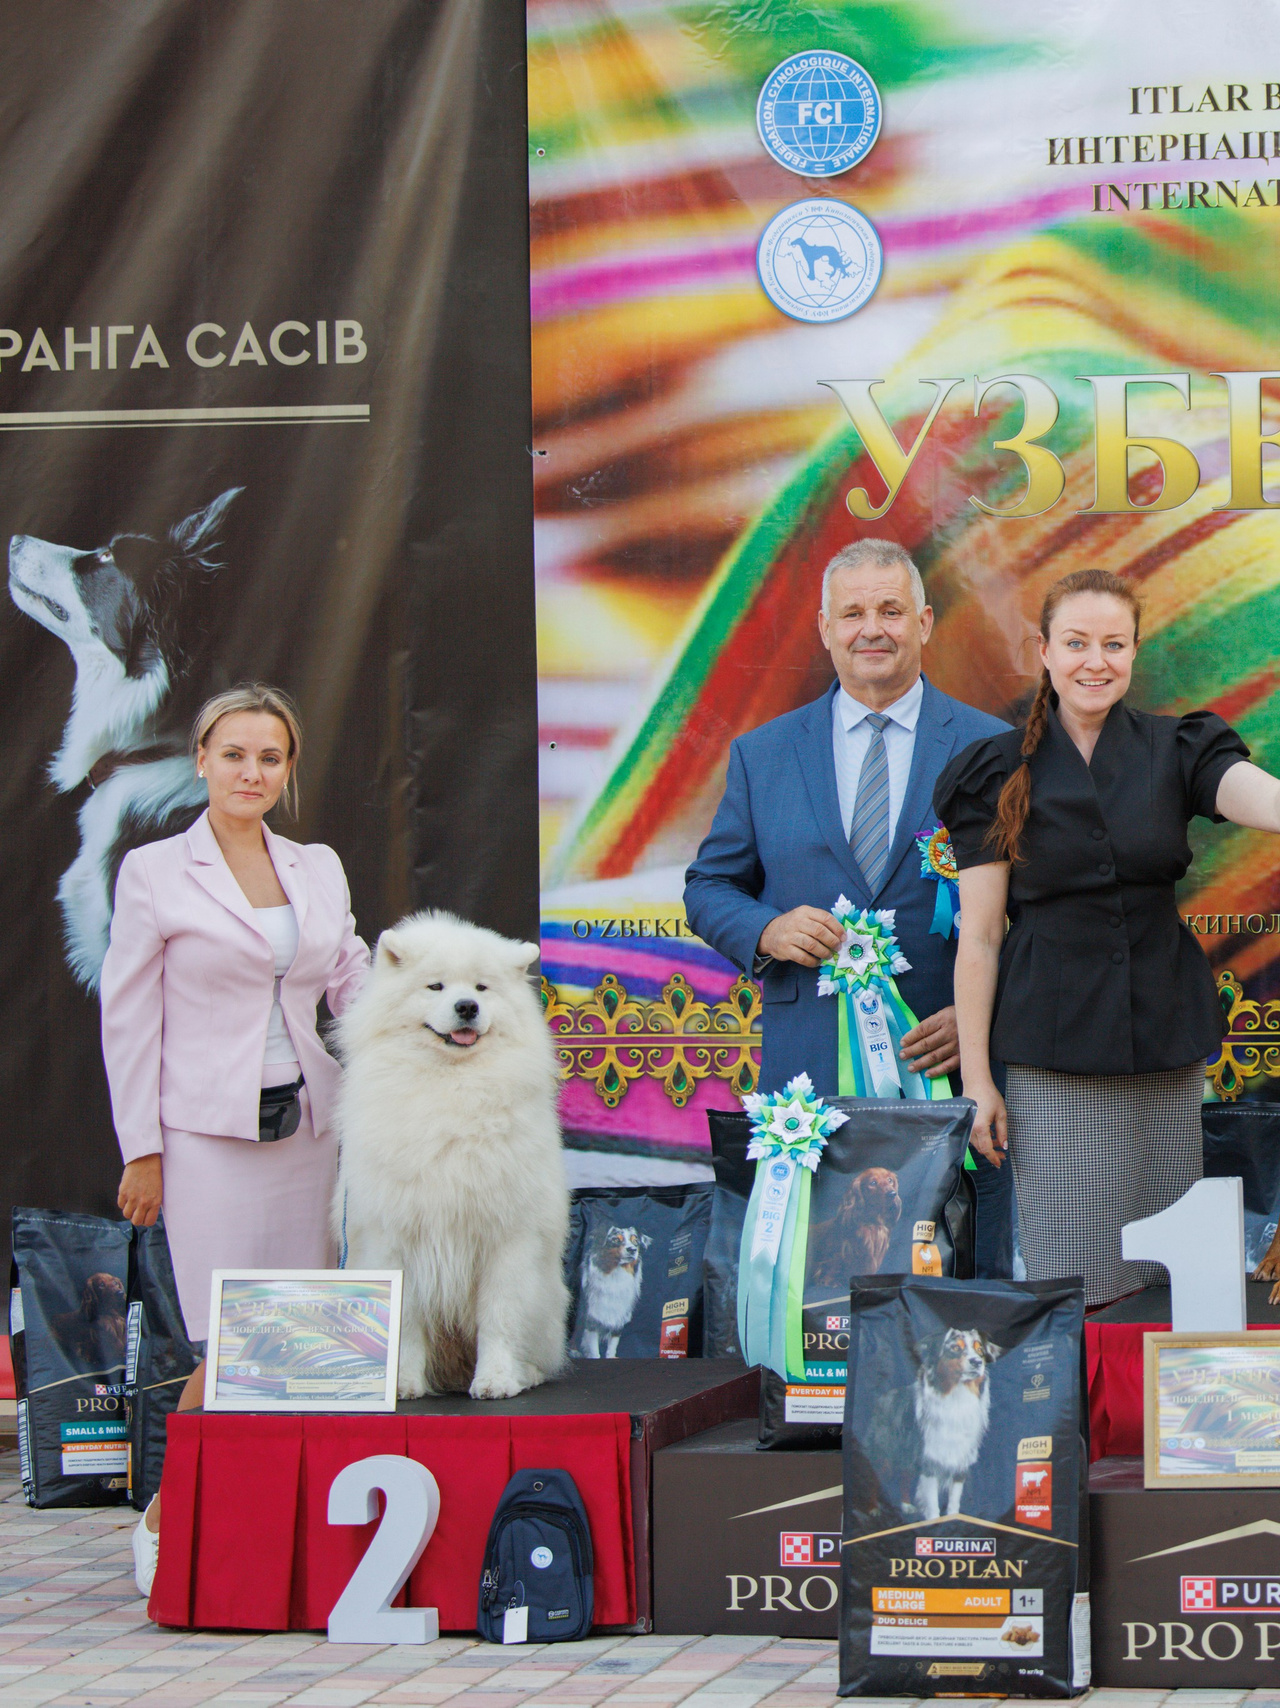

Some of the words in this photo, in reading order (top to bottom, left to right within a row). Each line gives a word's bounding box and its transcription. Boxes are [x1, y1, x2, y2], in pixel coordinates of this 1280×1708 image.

[768, 57, 850, 98] CYNOLOGIQUE
[1128, 84, 1252, 115] ITLAR
[798, 102, 842, 125] FCI
[831, 69, 876, 168] INTERNATIONALE
[763, 101, 807, 168] FEDERATION
[0, 324, 170, 373] РАНГА
[186, 319, 367, 368] CACIB
[572, 918, 696, 938] O'ZBEKIS
[870, 1041, 888, 1052] BIG
[878, 1052, 884, 1063] 1
[762, 1210, 780, 1221] BIG
[765, 1222, 774, 1233] 2
[1122, 1176, 1246, 1332] 1
[666, 1301, 685, 1310] HIGH
[308, 1325, 331, 1333] BEST
[280, 1341, 288, 1352] 2
[293, 1342, 332, 1351] место
[826, 1368, 834, 1377] &
[76, 1397, 119, 1413] PRO
[66, 1427, 97, 1436] SMALL
[98, 1427, 105, 1435] &
[1022, 1440, 1047, 1450] HIGH
[328, 1454, 441, 1644] 2
[889, 1558, 945, 1578] PRO
[725, 1574, 839, 1612] PRO
[878, 1590, 925, 1600] MEDIUM
[878, 1600, 885, 1609] &
[888, 1600, 925, 1610] LARGE
[964, 1596, 1003, 1607] ADULT
[1019, 1595, 1035, 1607] 1+
[878, 1617, 896, 1625] DUO
[898, 1617, 928, 1626] DELICE
[1122, 1621, 1244, 1661] PRO
